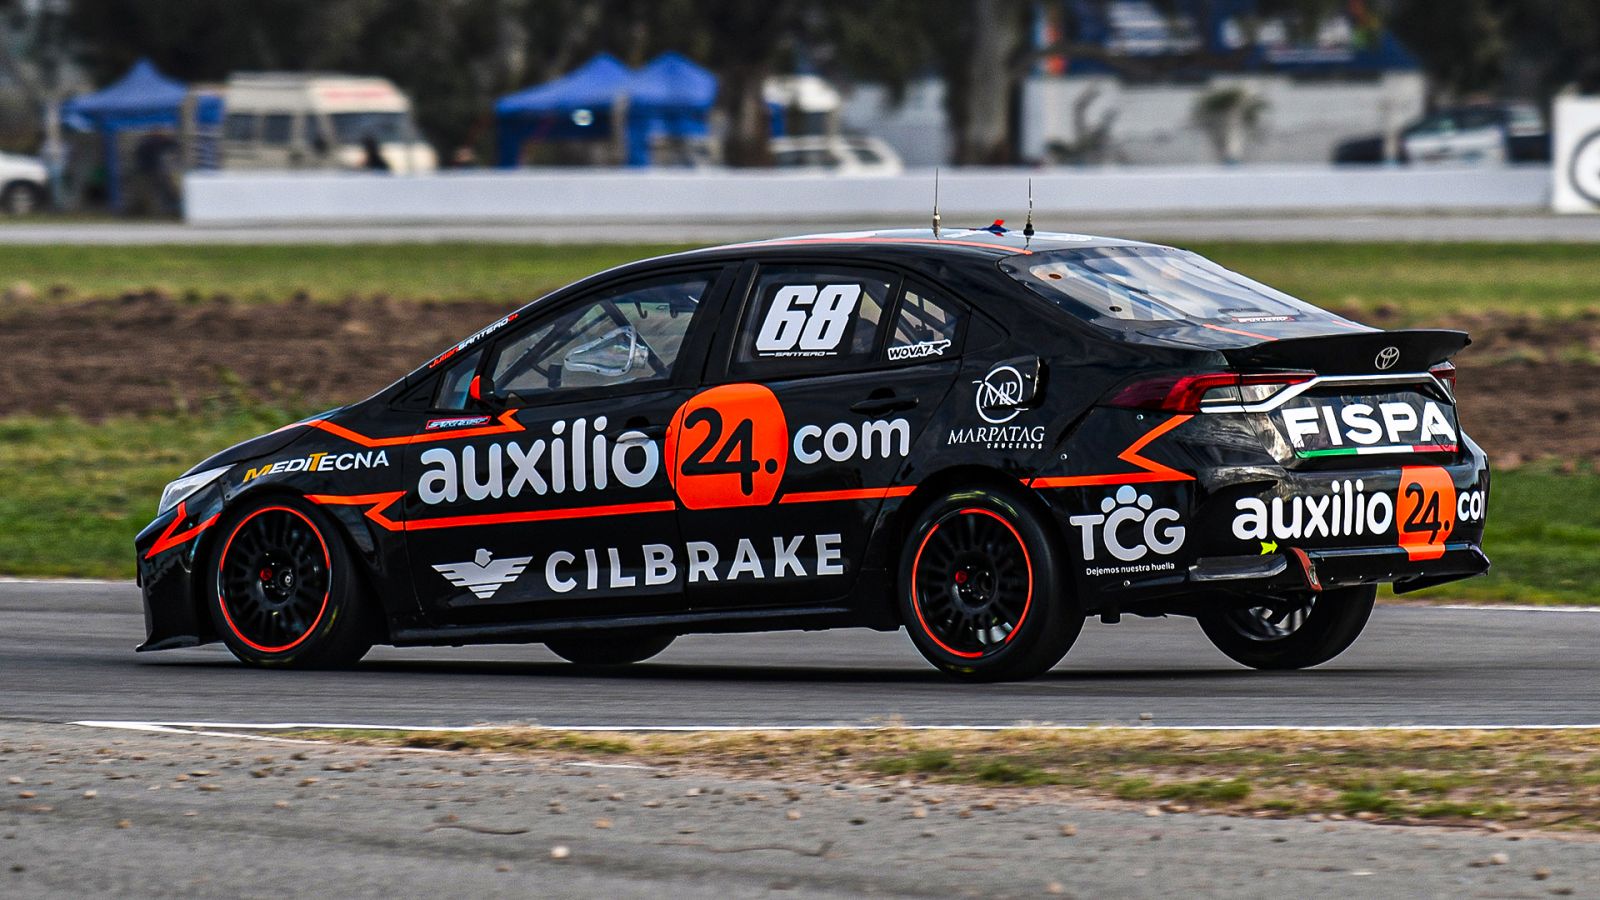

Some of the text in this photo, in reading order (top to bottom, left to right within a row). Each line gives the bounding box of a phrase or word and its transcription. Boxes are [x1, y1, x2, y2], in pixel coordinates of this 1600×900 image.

[756, 284, 861, 351] 68
[889, 344, 931, 360] WOVA7
[947, 426, 1045, 445] MARPATAG
[1281, 401, 1457, 449] FISPA
[986, 442, 1044, 450] CRUCEROS
[1069, 506, 1186, 562] TCG
[545, 533, 844, 593] CILBRAKE
[1086, 562, 1175, 577] Dejemos nuestra huella
